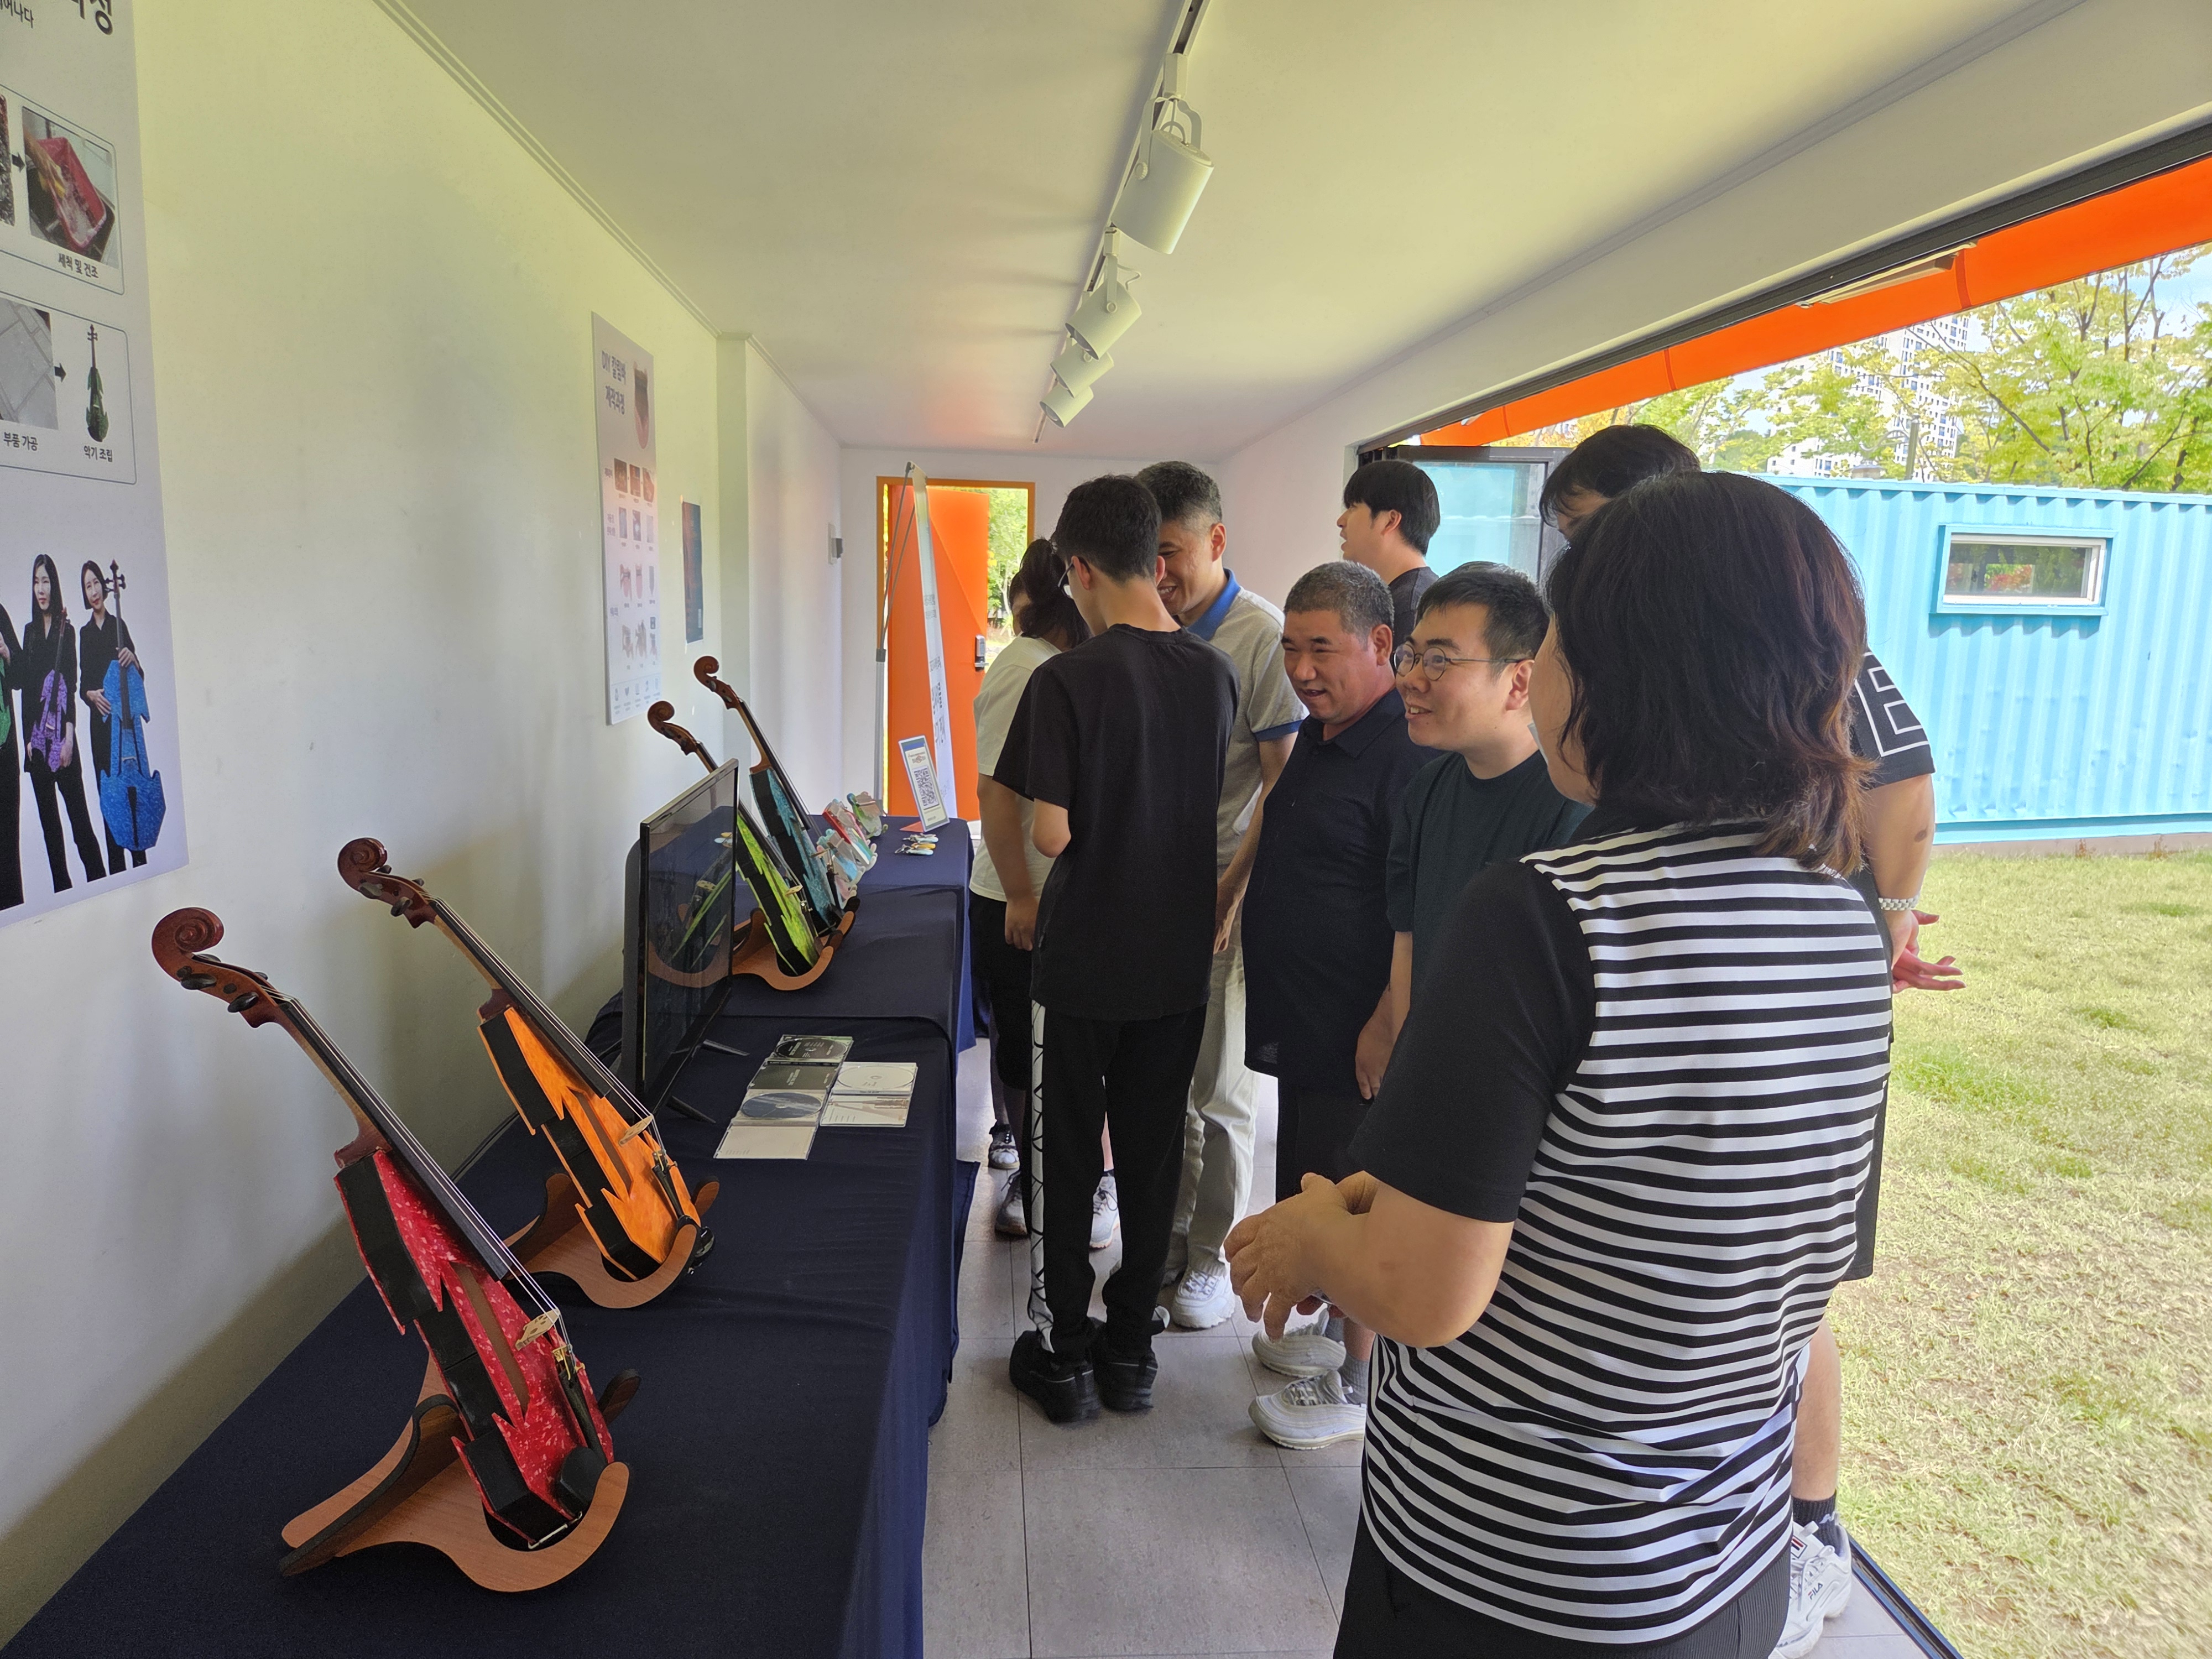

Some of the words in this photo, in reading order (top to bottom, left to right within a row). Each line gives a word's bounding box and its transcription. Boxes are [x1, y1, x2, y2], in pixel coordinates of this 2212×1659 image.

[58, 253, 73, 271] 세척
[75, 259, 82, 274] 및
[84, 263, 99, 278] 건조
[3, 431, 20, 448] 부품
[22, 436, 38, 451] 가공
[84, 445, 98, 461] 악기
[99, 448, 113, 462] 조립
[1808, 1582, 1823, 1600] FILA
